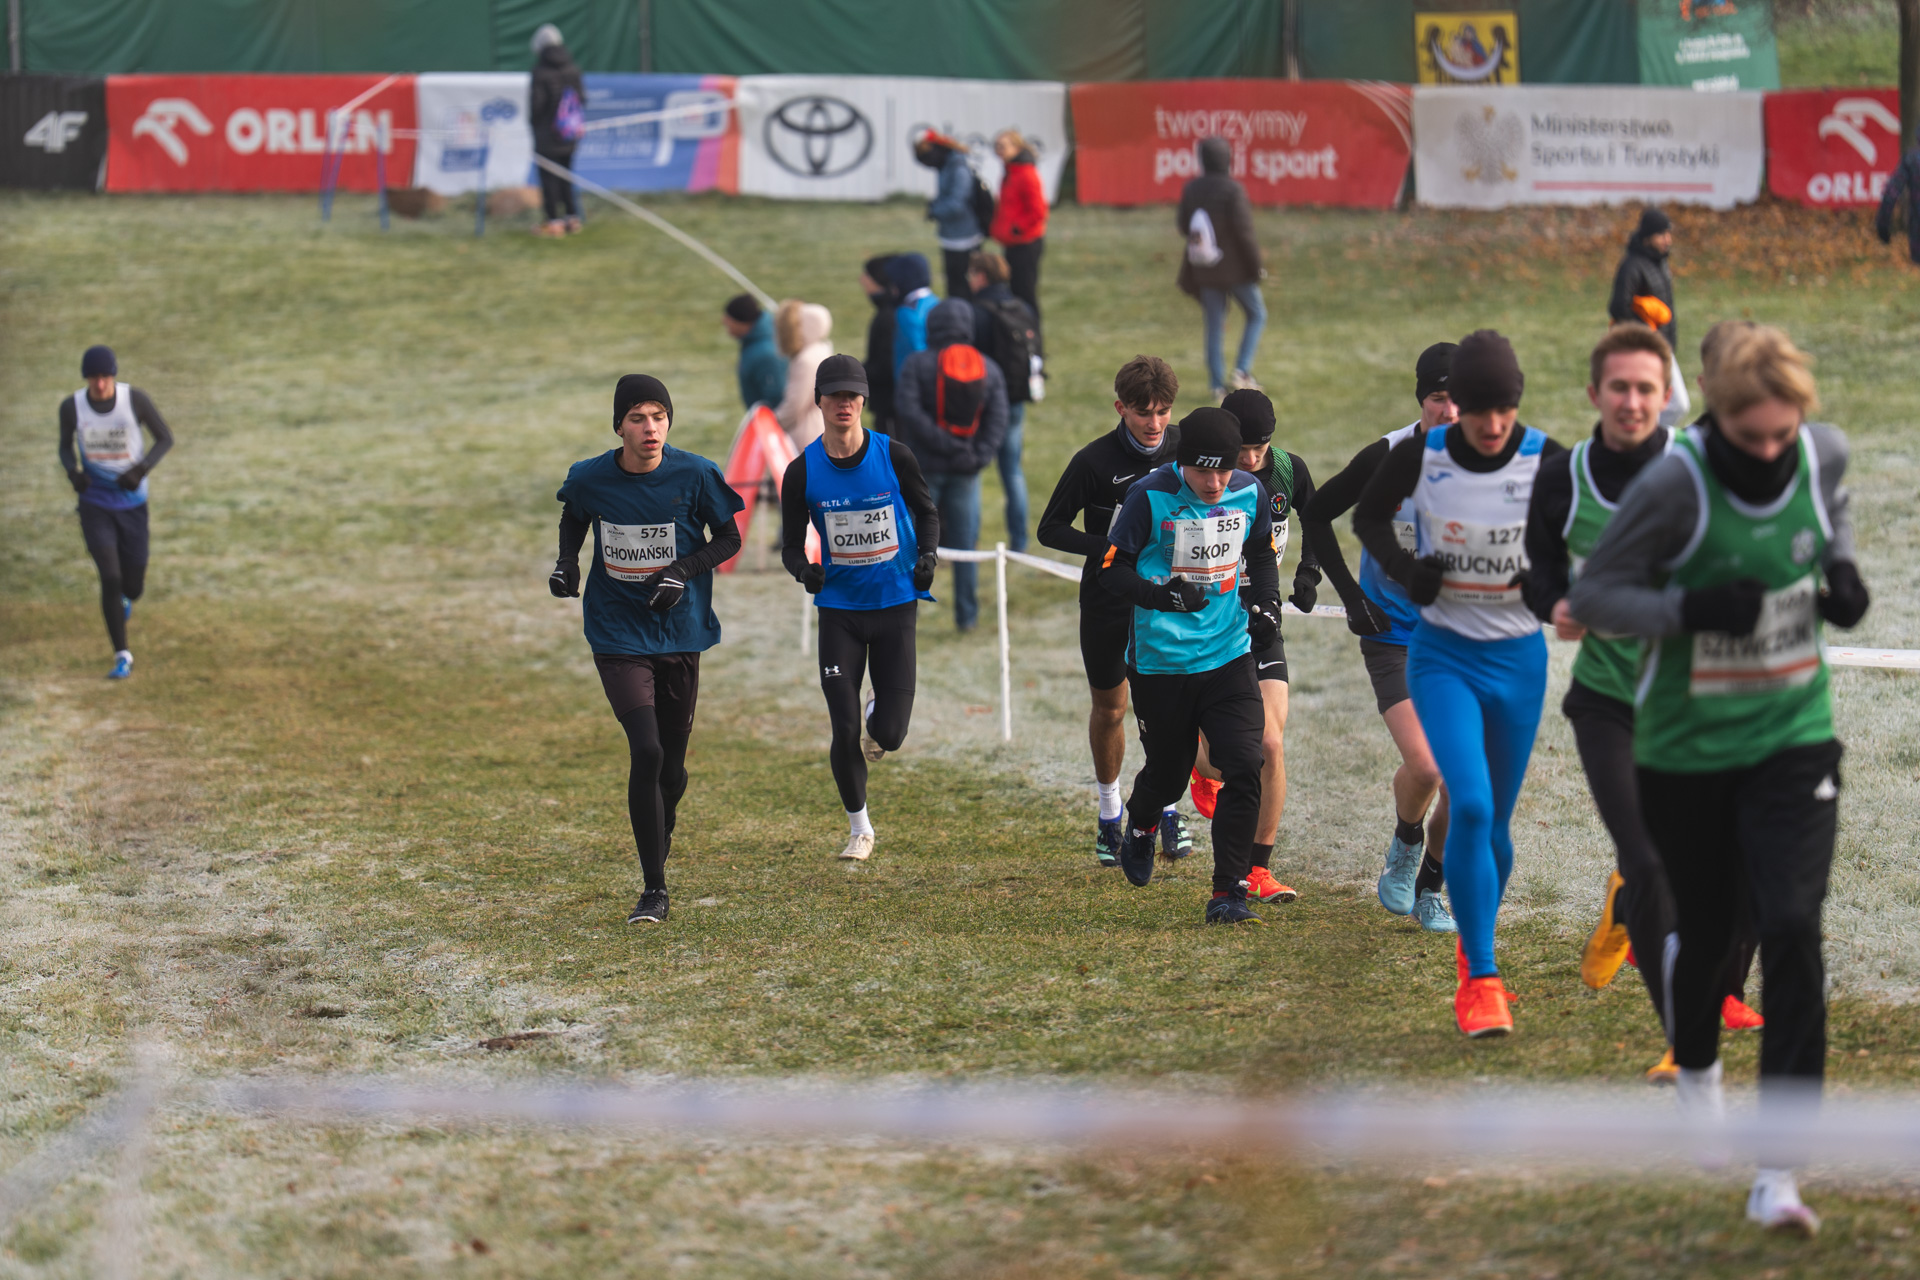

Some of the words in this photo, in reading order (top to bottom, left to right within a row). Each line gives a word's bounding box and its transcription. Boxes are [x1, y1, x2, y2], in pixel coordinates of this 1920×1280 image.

[24, 110, 88, 153] 4F
[226, 106, 393, 155] ORLEN
[1154, 104, 1308, 147] tworzymy
[1530, 112, 1673, 138] Ministerstwo
[1154, 137, 1248, 185] poli
[1252, 144, 1339, 186] sport
[1530, 141, 1602, 169] Sportu
[1607, 143, 1617, 167] i
[1622, 143, 1720, 171] Turystyki
[1806, 171, 1888, 204] ORLE
[864, 509, 889, 525] 241
[1217, 517, 1241, 533] 555
[640, 527, 668, 539] 575
[833, 528, 892, 547] OZIMEK
[1488, 526, 1522, 546] 127
[604, 544, 674, 562] CHOWAŃSKI
[1190, 542, 1231, 560] SKOP
